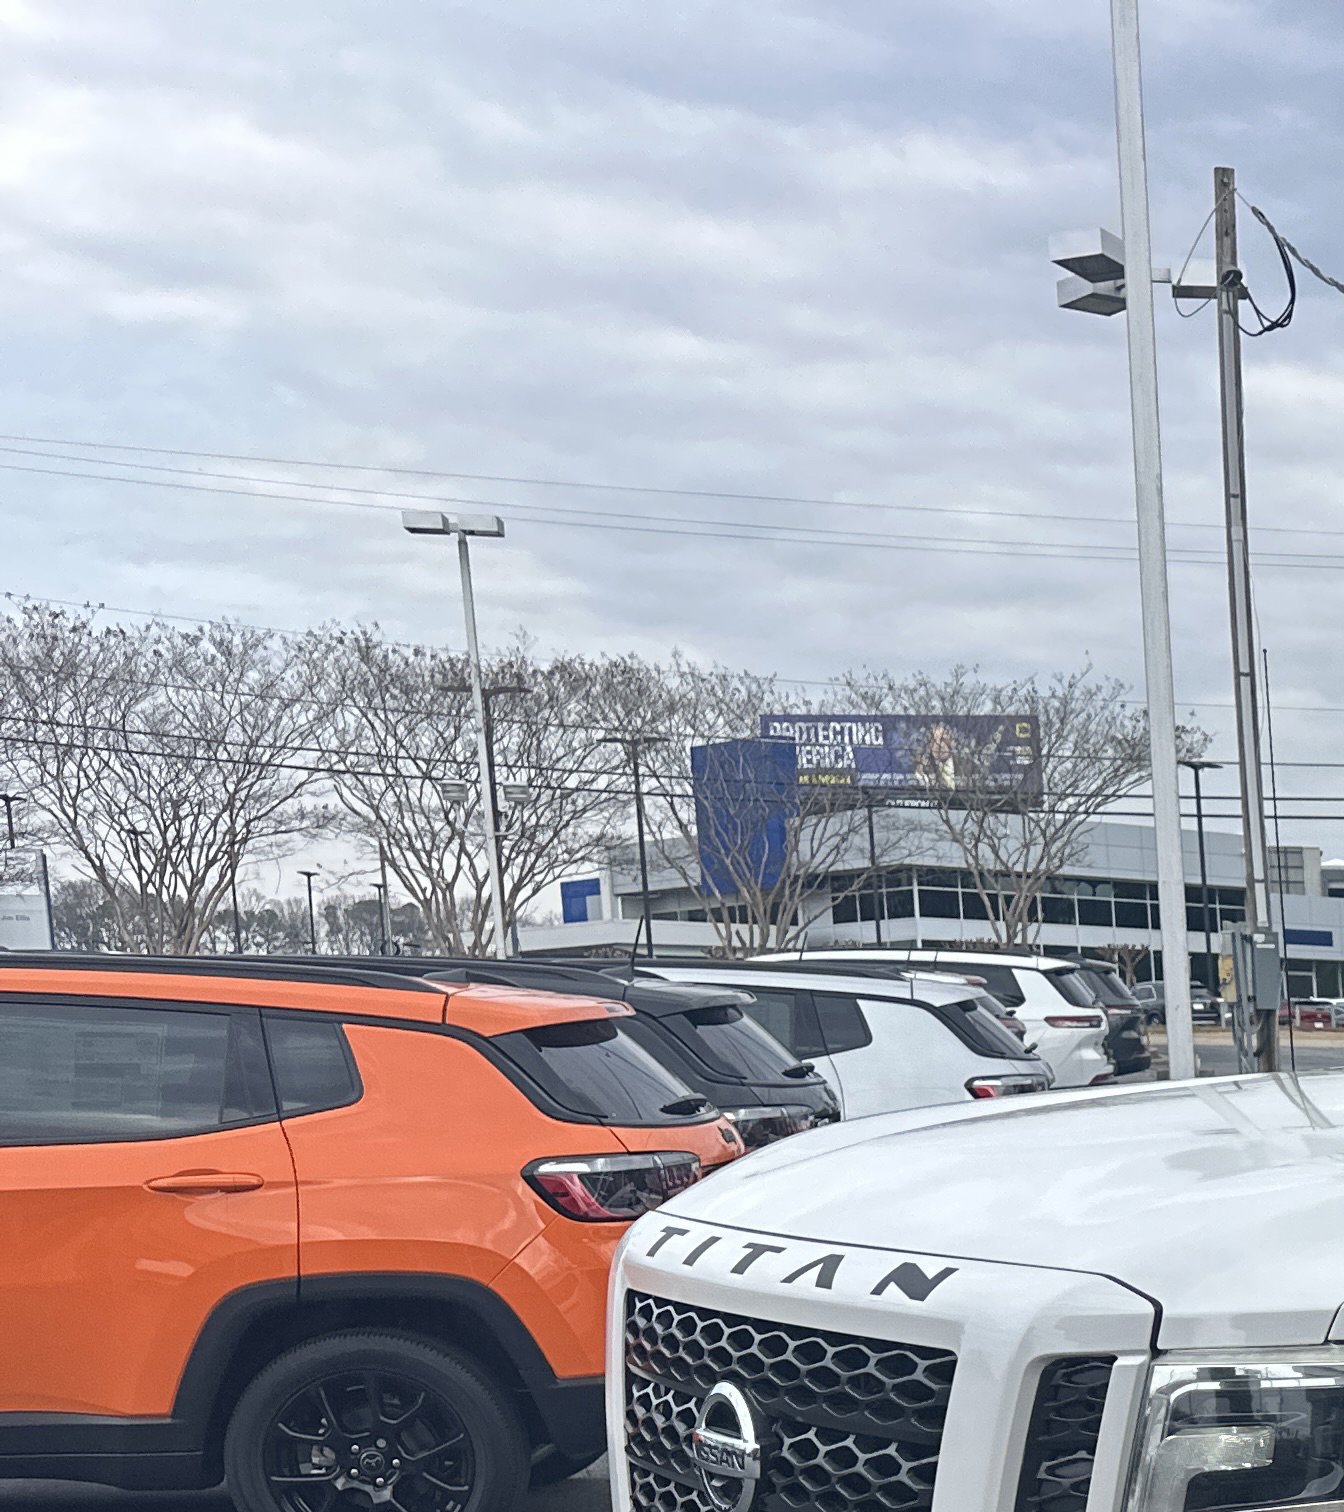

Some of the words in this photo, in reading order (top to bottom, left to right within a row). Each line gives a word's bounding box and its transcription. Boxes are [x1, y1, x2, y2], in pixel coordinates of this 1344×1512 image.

[796, 745, 856, 769] ERICA
[645, 1225, 960, 1302] TITAN
[696, 1443, 745, 1471] SSAN
